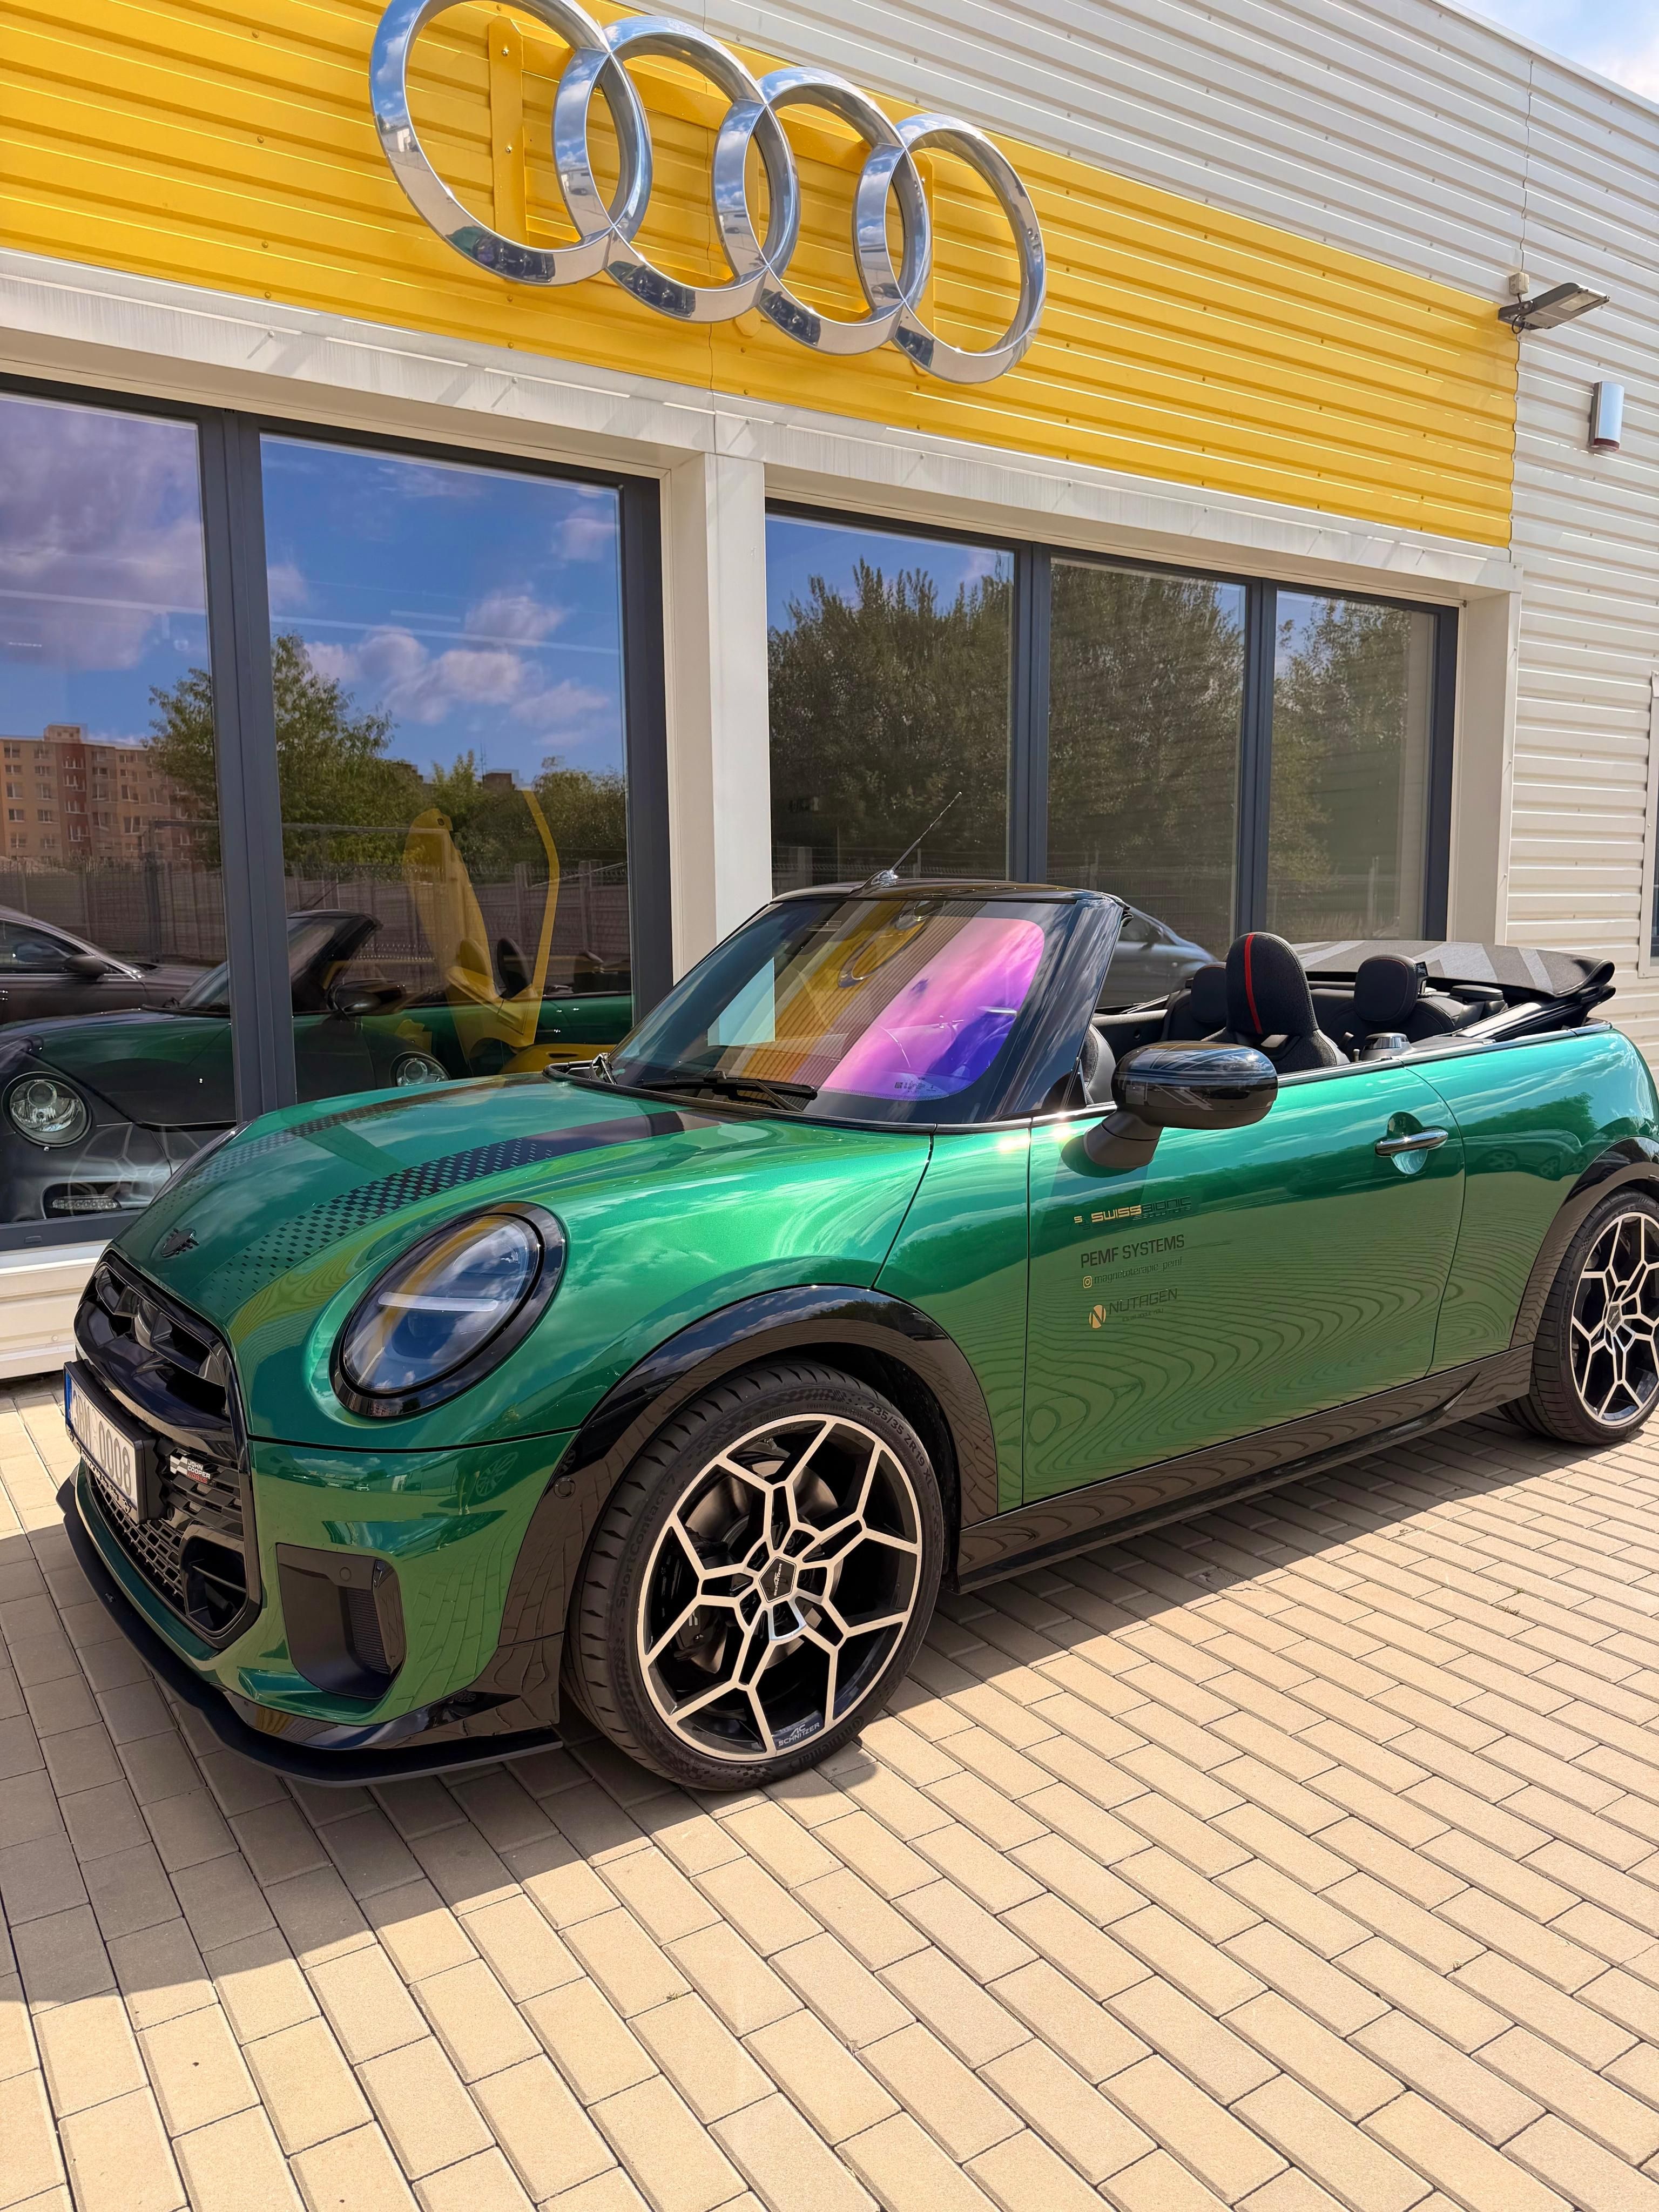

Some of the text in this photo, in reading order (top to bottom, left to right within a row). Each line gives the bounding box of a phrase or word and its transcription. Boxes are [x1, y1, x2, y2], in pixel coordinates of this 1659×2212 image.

[1081, 1234, 1184, 1268] PEMF SYSTEMS
[1109, 1288, 1178, 1314] NUTAGEN
[98, 1420, 131, 1496] 0008
[867, 1402, 904, 1435] 235/35
[923, 1468, 933, 1489] XL
[187, 1460, 203, 1471] JOHN
[187, 1466, 211, 1480] COOPER
[187, 1472, 208, 1484] WORKS
[616, 1489, 668, 1608] SportContact
[778, 1722, 820, 1746] SCHNITZER
[791, 1724, 806, 1737] AC
